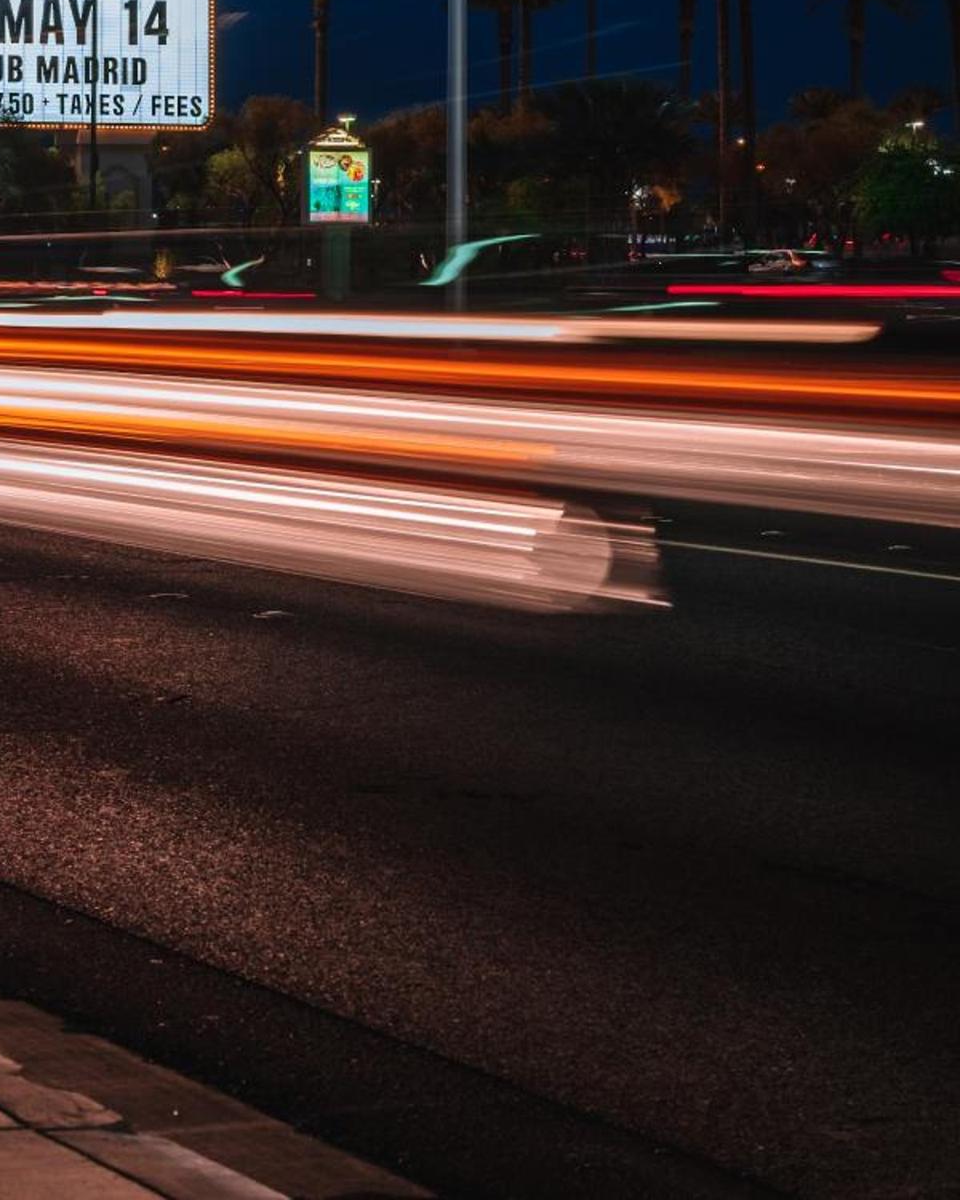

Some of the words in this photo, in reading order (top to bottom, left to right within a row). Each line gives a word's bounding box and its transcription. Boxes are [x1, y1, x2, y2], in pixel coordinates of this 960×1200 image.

[124, 0, 169, 46] 14
[36, 55, 148, 86] MADRID
[151, 95, 202, 117] FEES
